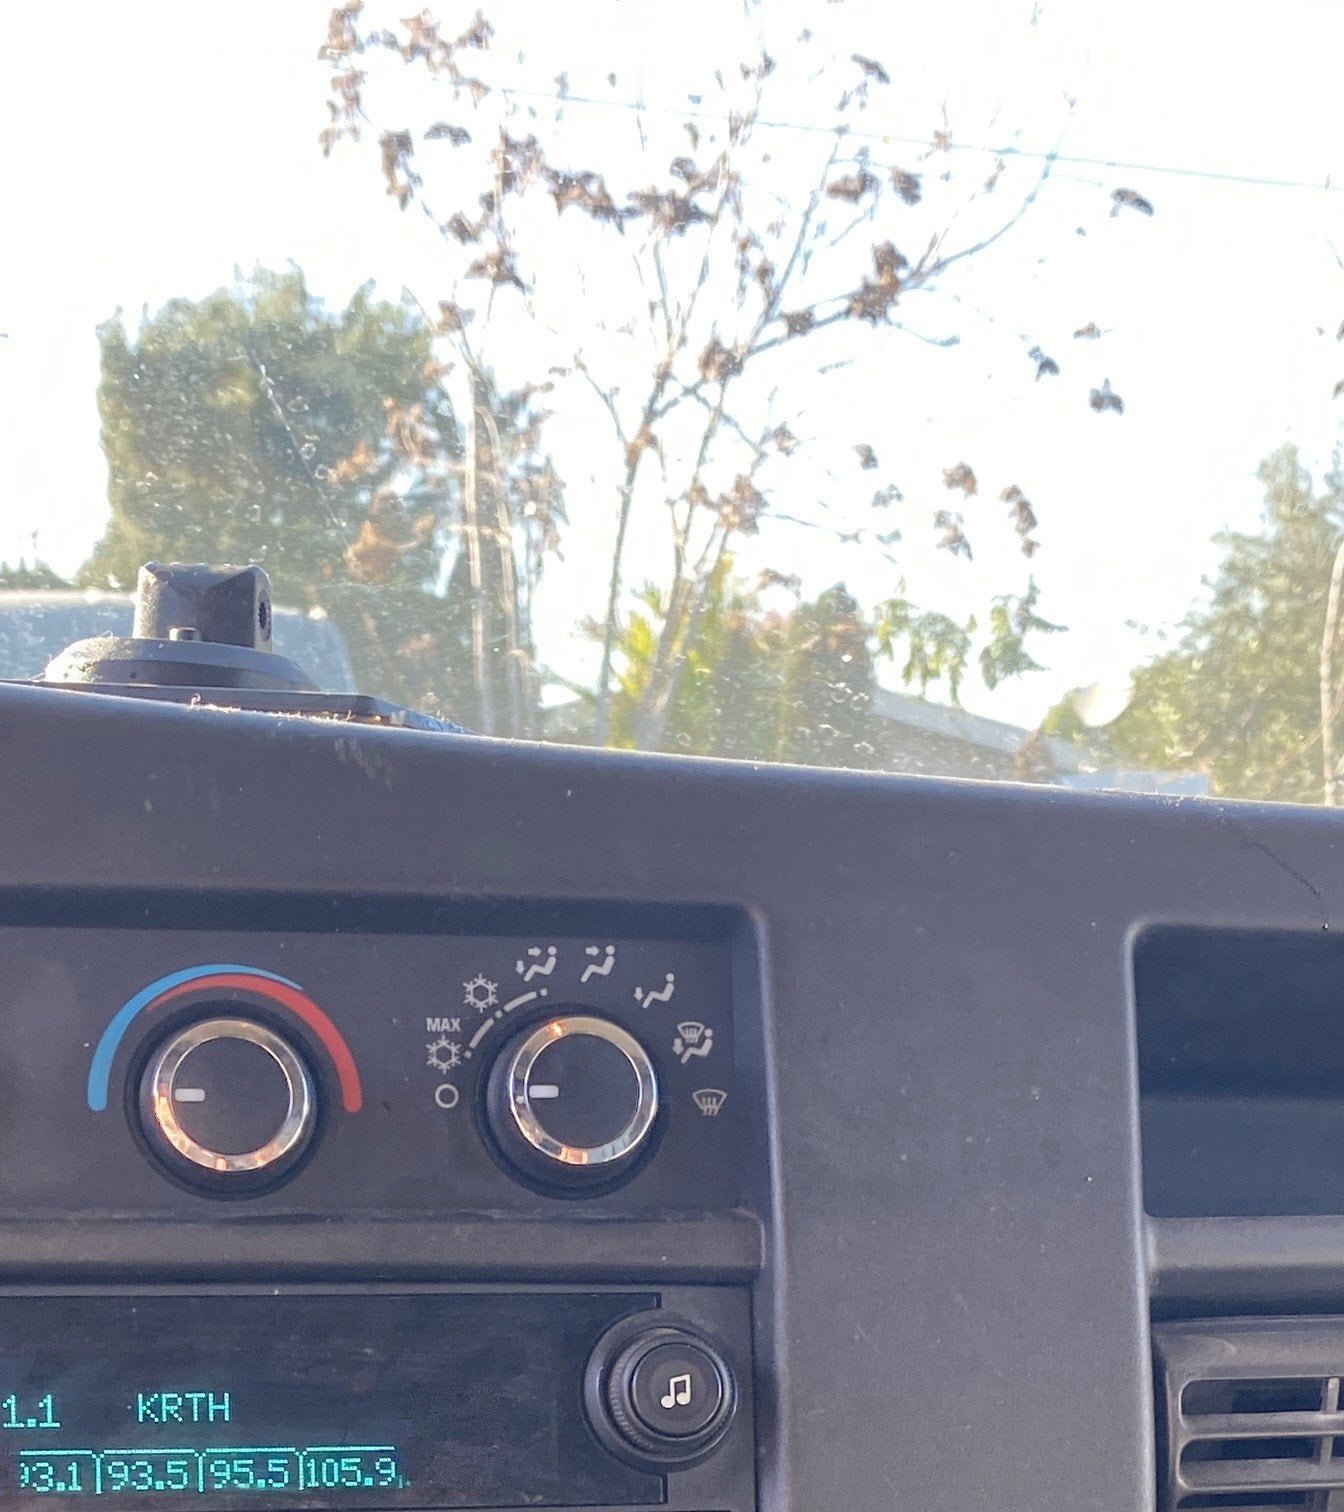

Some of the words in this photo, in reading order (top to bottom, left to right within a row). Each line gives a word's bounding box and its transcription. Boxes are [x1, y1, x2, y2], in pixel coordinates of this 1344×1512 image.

[425, 1016, 461, 1033] MAX
[2, 1394, 61, 1429] 1.1
[137, 1392, 231, 1423] KRTH
[107, 1460, 188, 1491] 93.5
[209, 1458, 289, 1489] 95.5
[306, 1457, 396, 1487] 105.9
